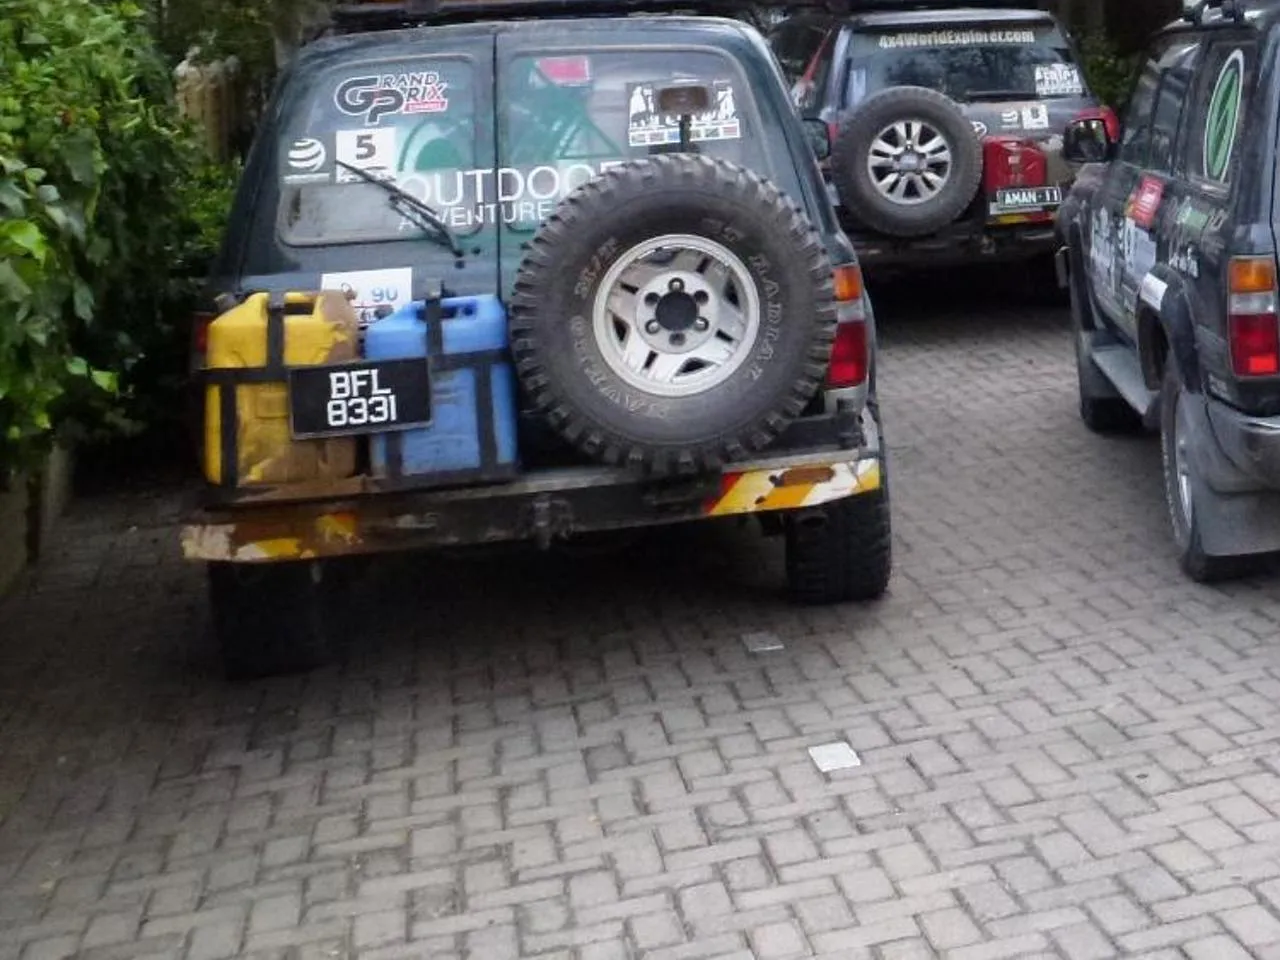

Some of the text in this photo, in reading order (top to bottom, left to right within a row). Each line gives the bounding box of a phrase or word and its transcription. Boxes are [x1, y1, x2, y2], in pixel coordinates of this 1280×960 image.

[878, 29, 1036, 49] 4x4WorldExplorer.com
[355, 133, 376, 160] 5
[399, 161, 624, 207] OUTDOO
[329, 369, 392, 400] BFL
[327, 395, 397, 427] 8331
